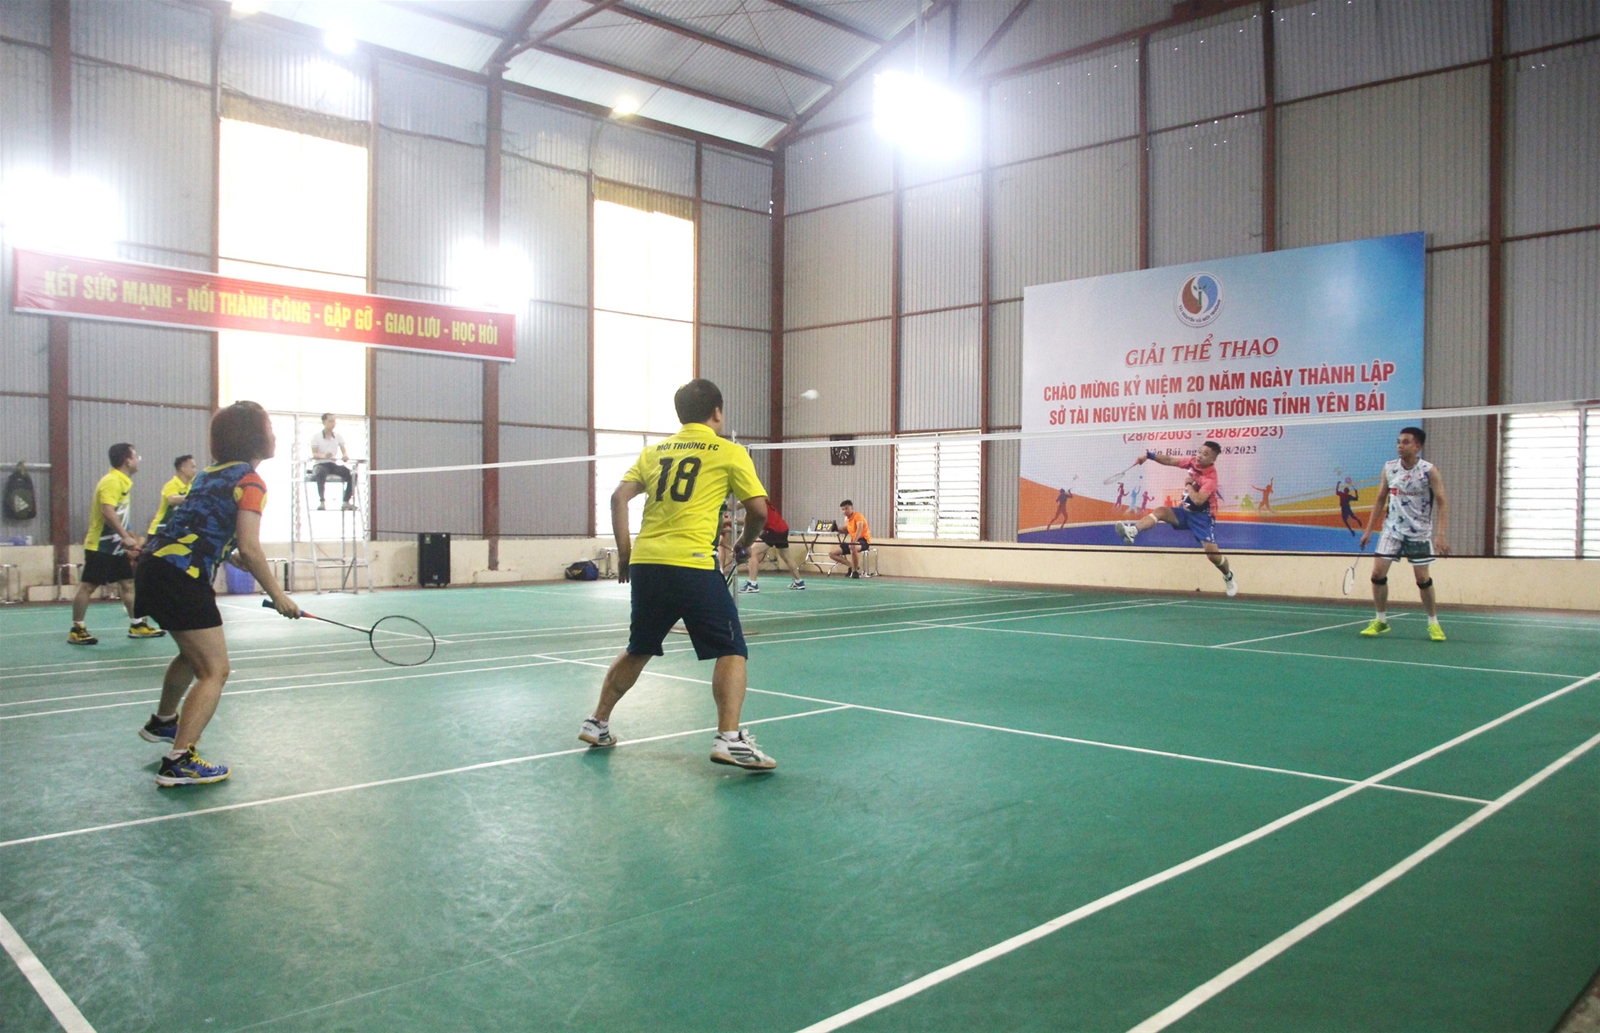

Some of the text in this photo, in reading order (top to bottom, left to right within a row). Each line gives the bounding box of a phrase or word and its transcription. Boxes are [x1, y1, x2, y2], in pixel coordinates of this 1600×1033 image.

[44, 265, 77, 298] KẾT
[83, 272, 117, 302] SỨC
[123, 280, 172, 310] MẠNH
[187, 282, 215, 313] NỐI
[219, 289, 268, 319] THÀNH
[272, 295, 312, 325] CÔNG
[323, 302, 351, 332] GẶP
[385, 312, 414, 336] GIAO
[417, 315, 441, 338] LƯU
[451, 321, 476, 346] HỌC
[478, 318, 498, 345] HỎI
[1125, 333, 1279, 367] GIẢI THỂ THAO
[1043, 359, 1395, 402] CHÀO MỪNG KỶ NIỆM 20 NĂM NGÀY THÀNH LẬP
[1049, 389, 1385, 425] SỞ TÀI NGUYÊN VÀ MÔI TRƯỜNG TỈNH YÊN BÁI
[708, 443, 719, 451] FC
[1206, 425, 1284, 439] 28/8/2023)
[655, 455, 702, 502] 18
